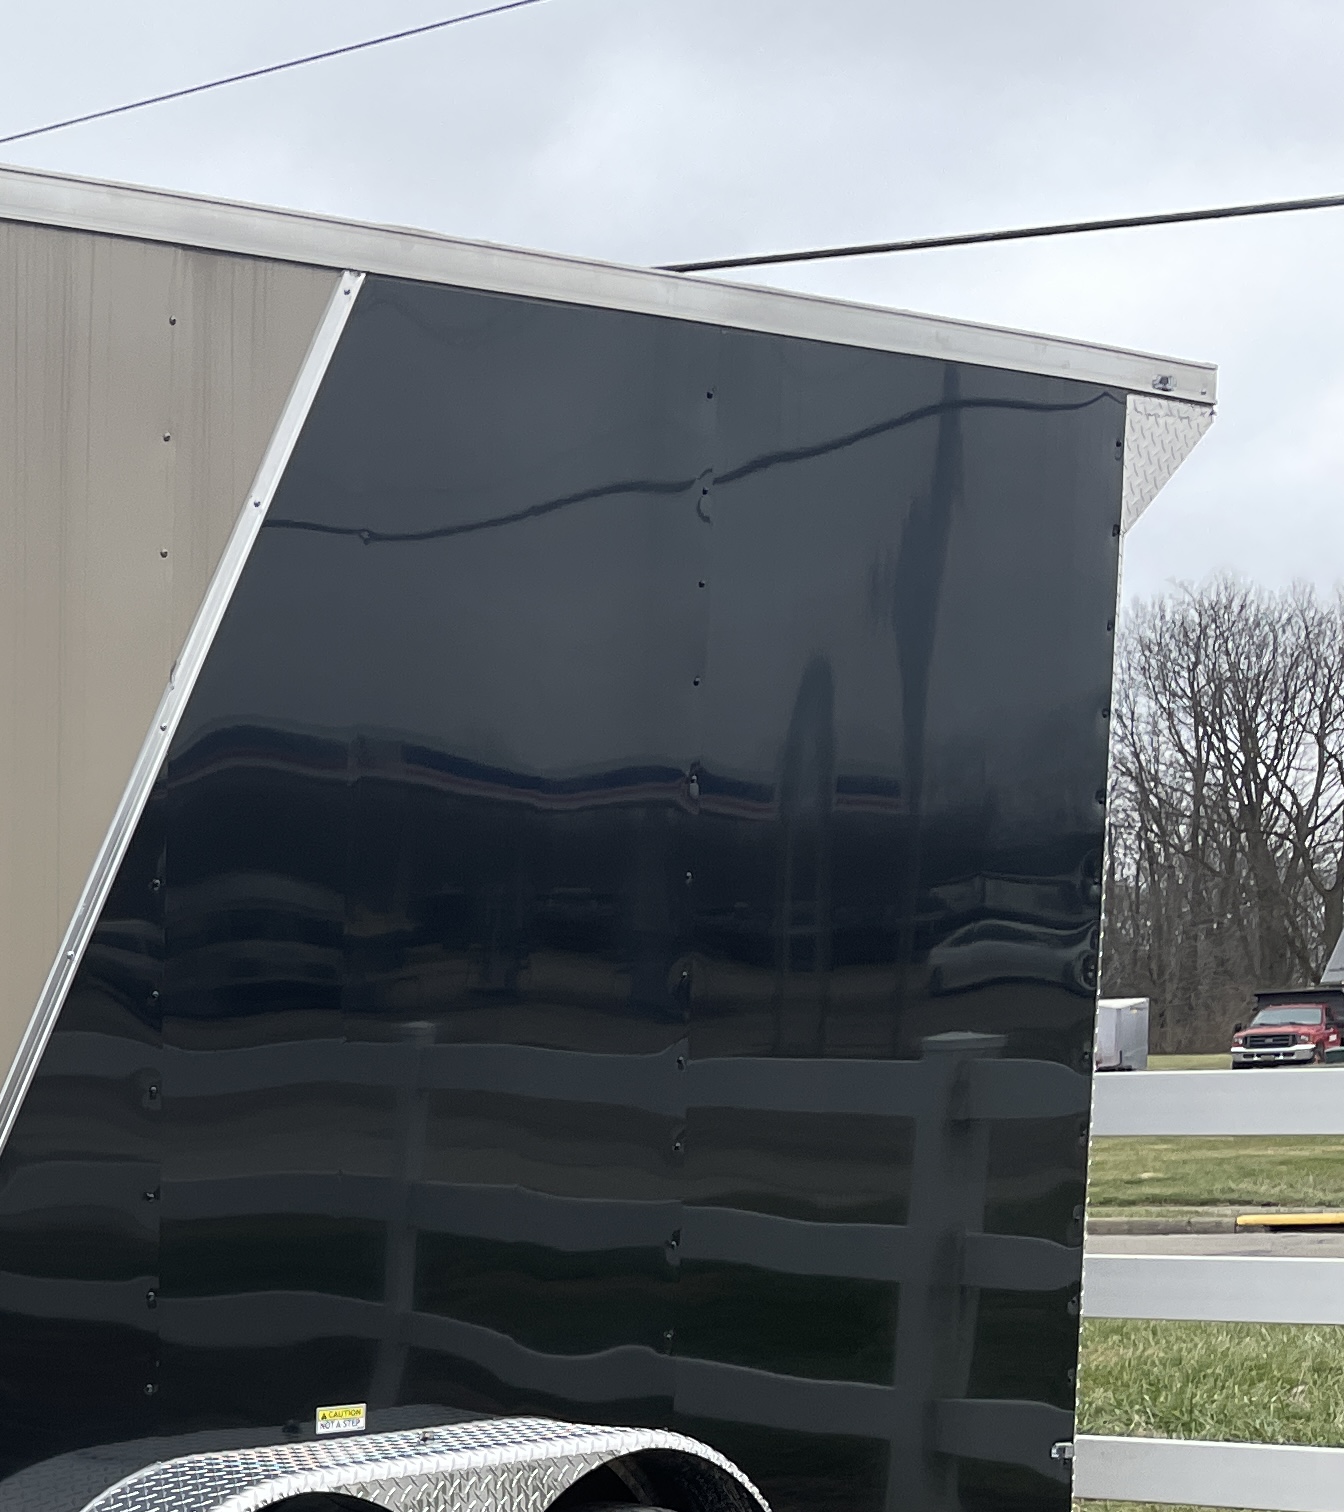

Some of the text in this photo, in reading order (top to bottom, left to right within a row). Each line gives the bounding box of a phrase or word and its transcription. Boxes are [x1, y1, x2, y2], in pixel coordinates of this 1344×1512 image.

[328, 1408, 362, 1419] CAUTION
[320, 1420, 334, 1430] NOT
[342, 1418, 361, 1428] STEP
